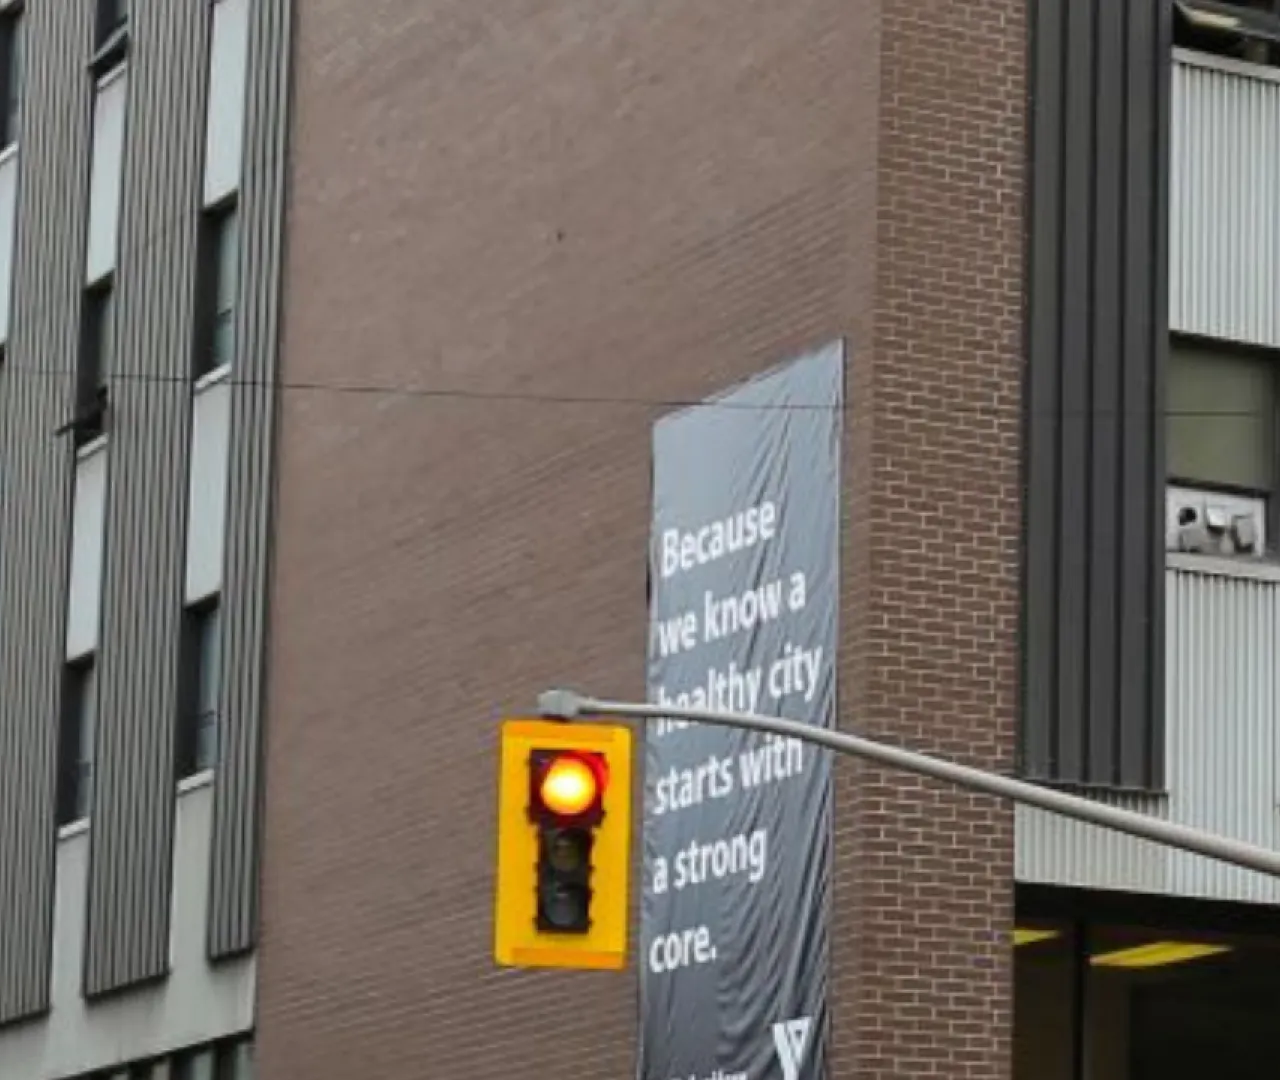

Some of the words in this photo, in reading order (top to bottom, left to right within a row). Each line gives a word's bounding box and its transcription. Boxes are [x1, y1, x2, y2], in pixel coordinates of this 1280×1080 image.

[660, 500, 777, 578] Because
[658, 614, 699, 658] we
[704, 577, 783, 643] know
[789, 570, 807, 611] a
[656, 660, 762, 736] healthy
[770, 641, 823, 704] city
[652, 754, 734, 816] starts
[739, 732, 803, 790] with
[652, 856, 669, 894] a
[674, 829, 768, 890] strong
[649, 924, 718, 973] core.
